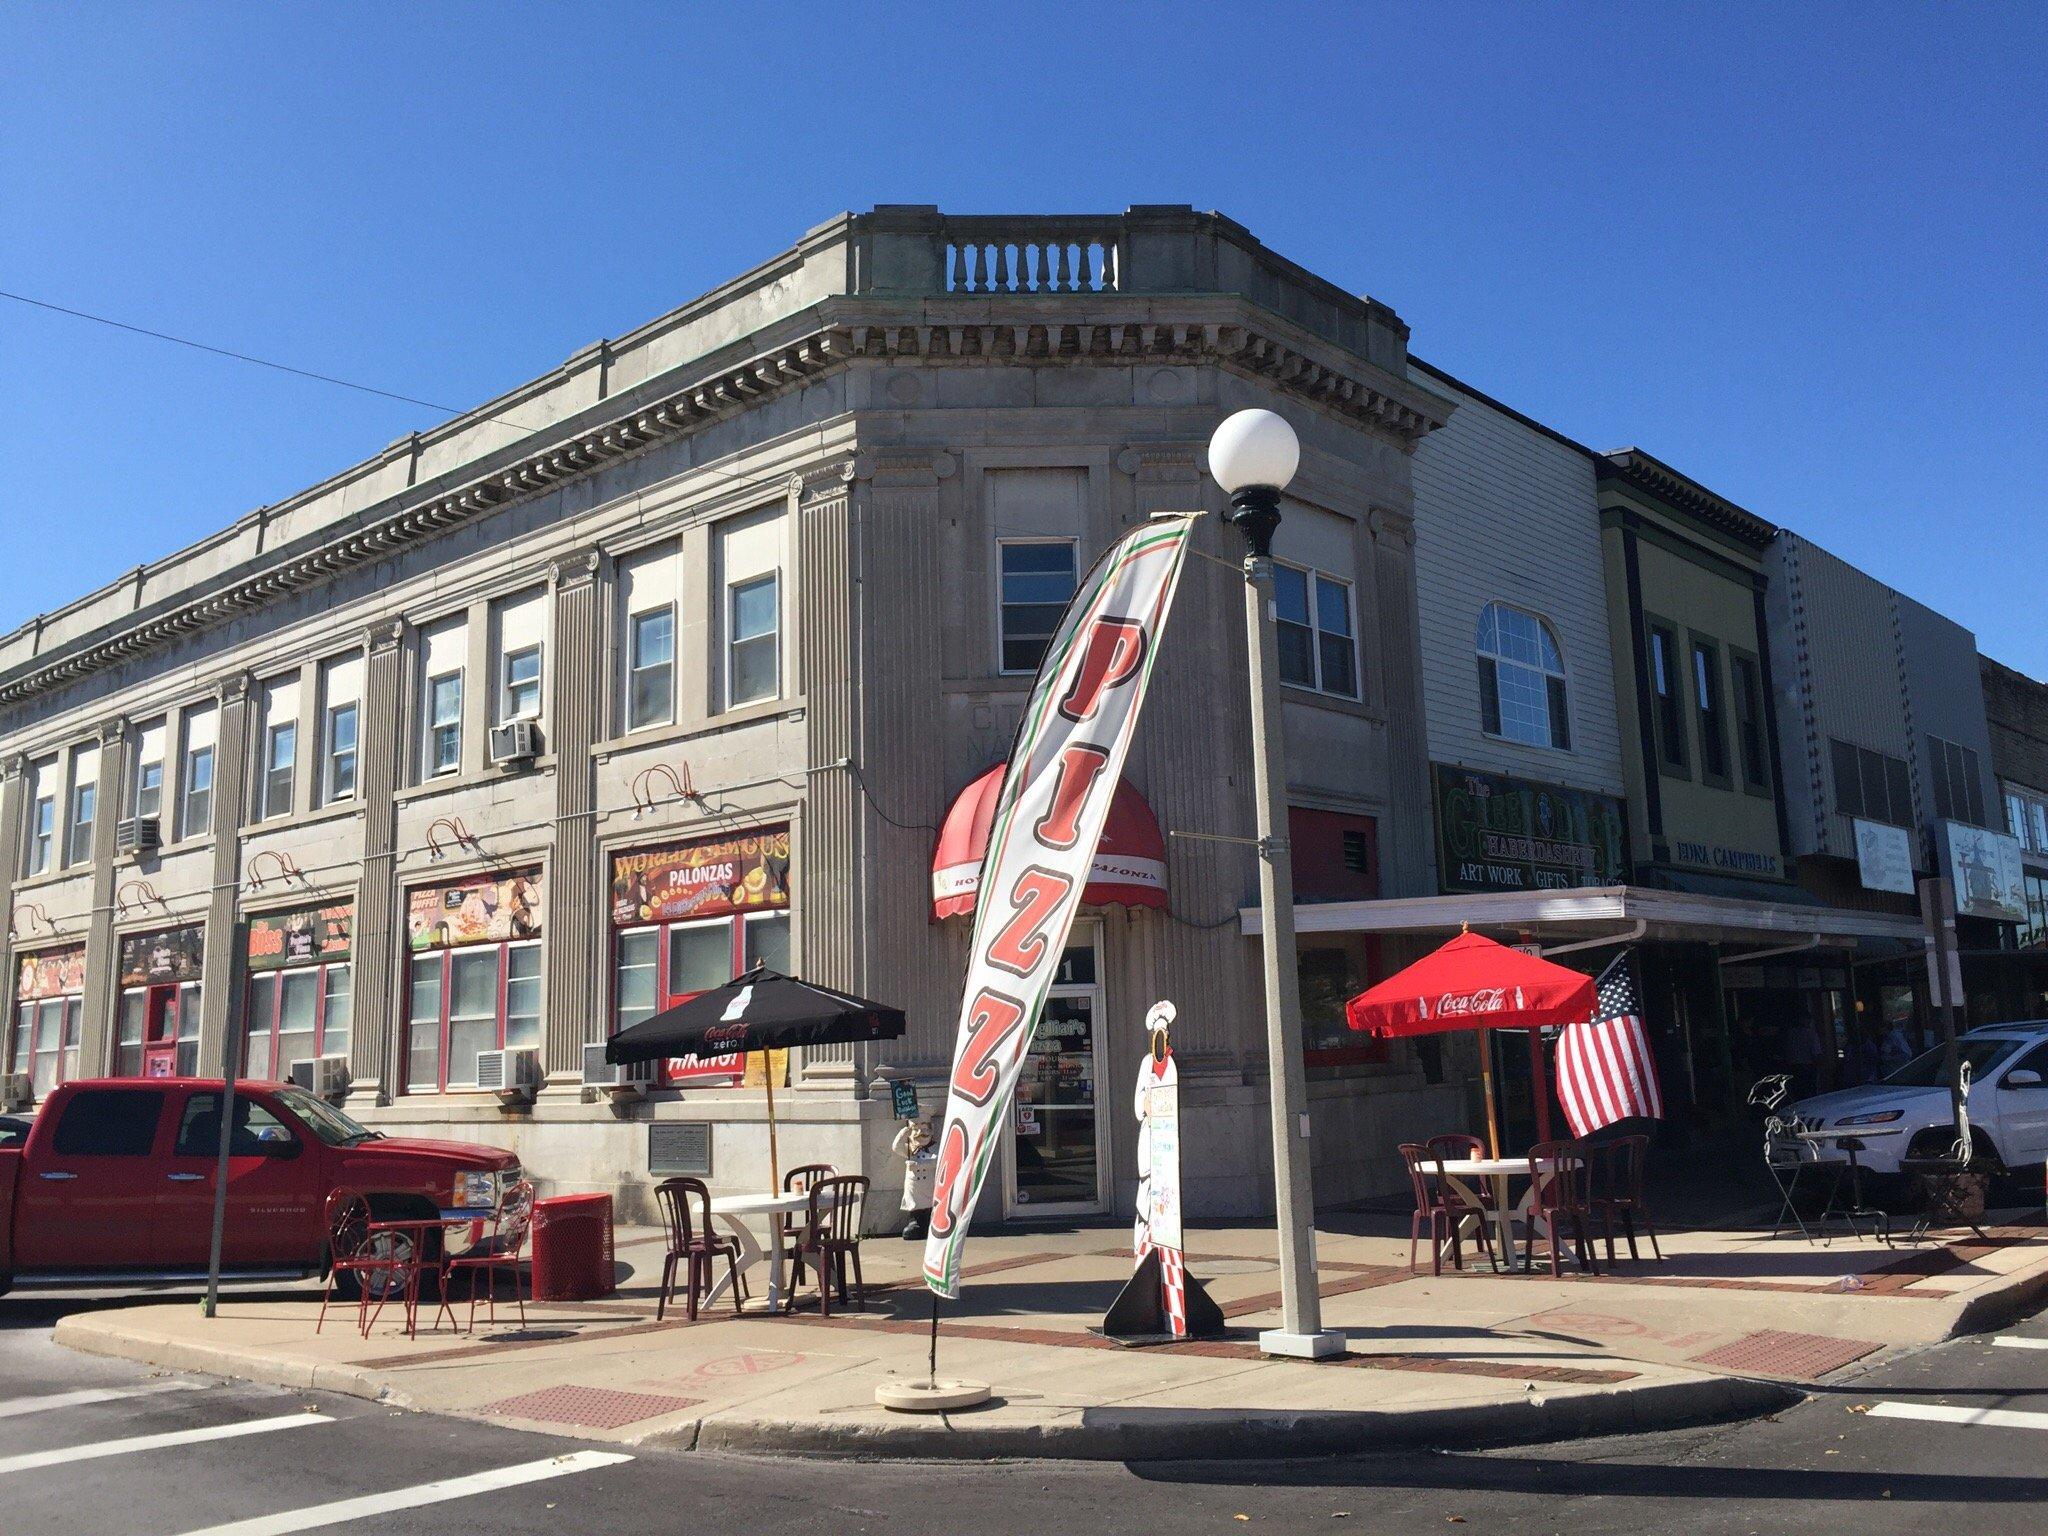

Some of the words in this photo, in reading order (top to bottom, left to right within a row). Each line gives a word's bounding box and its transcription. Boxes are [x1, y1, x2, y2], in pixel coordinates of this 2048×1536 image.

[1465, 776, 1492, 798] The
[1487, 834, 1597, 869] HABERDASHERY
[669, 862, 734, 887] PALONZAS
[1460, 862, 1484, 883] ART
[1487, 863, 1524, 887] WORK
[1536, 869, 1569, 890] GIFTS
[410, 897, 439, 912] BUFFET
[412, 889, 437, 898] PIZZA
[931, 614, 1148, 1240] PIZZA
[1437, 987, 1507, 1016] Coca-Cola
[704, 1022, 751, 1042] Coca-Cola
[713, 1039, 737, 1050] zero
